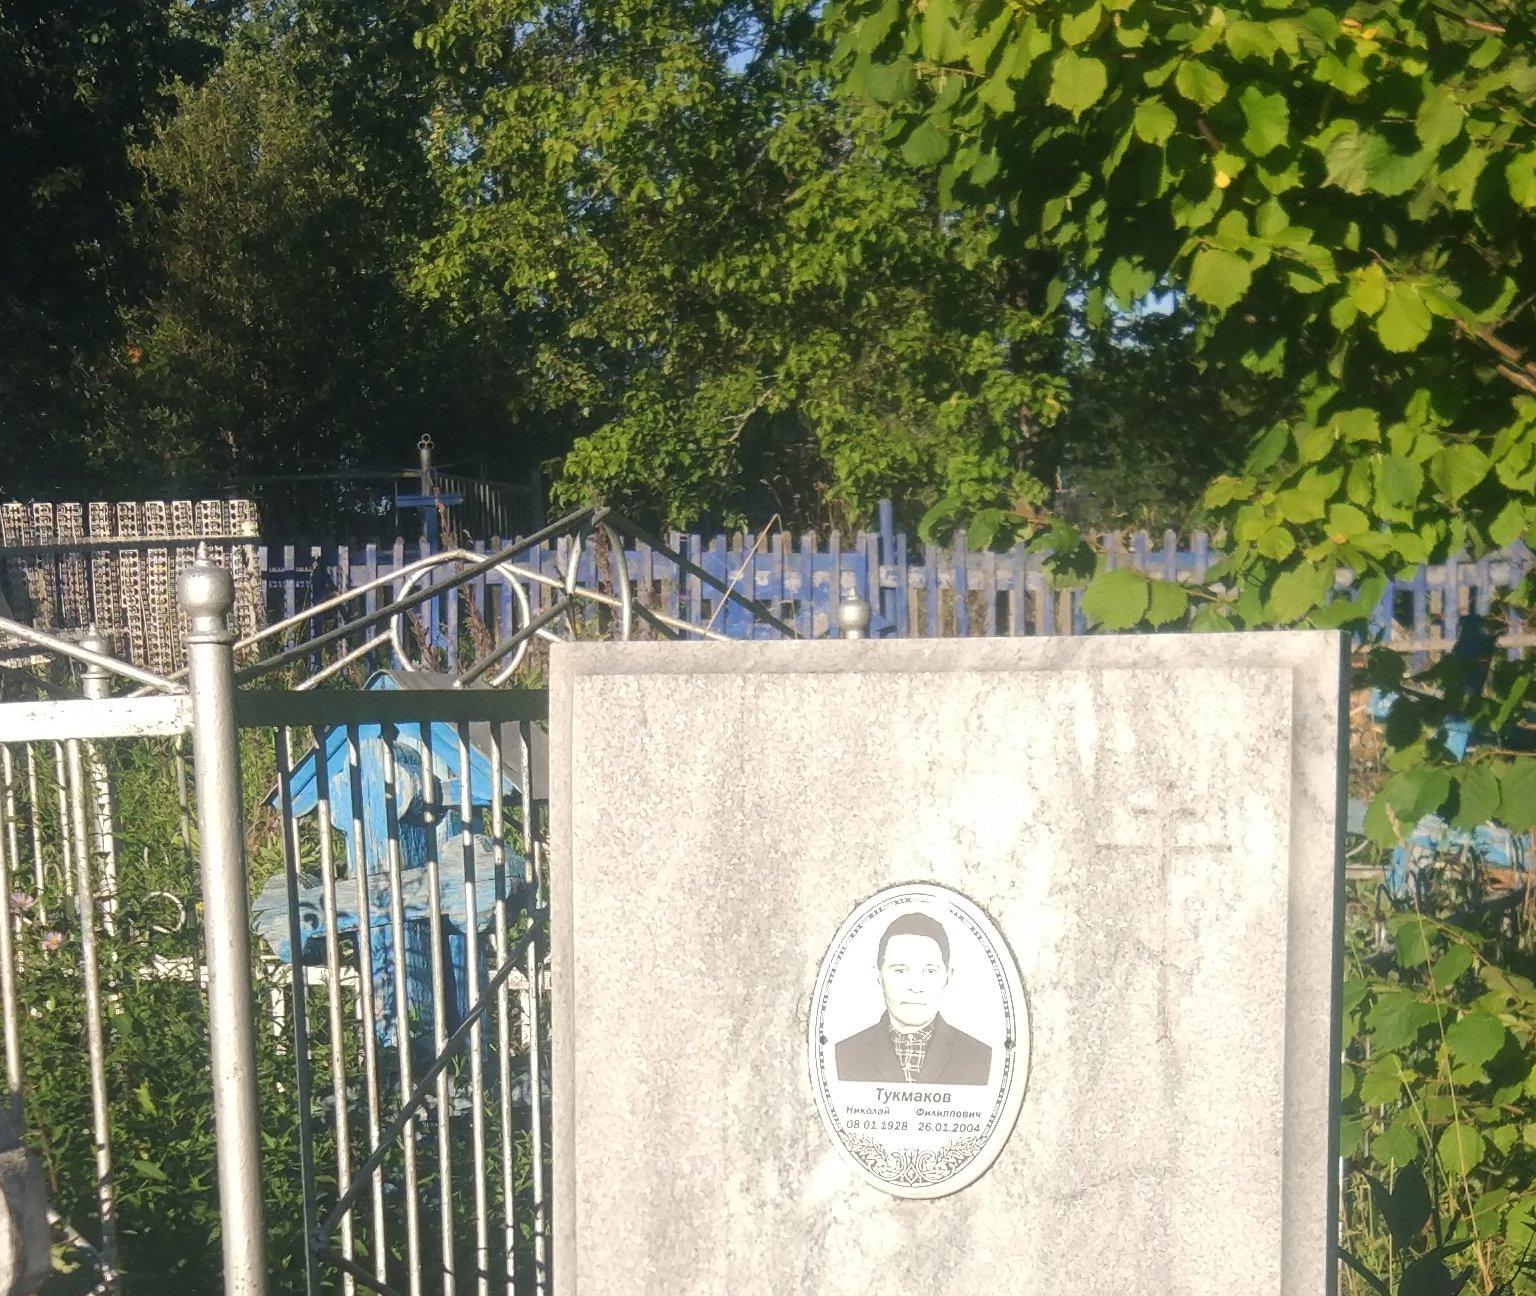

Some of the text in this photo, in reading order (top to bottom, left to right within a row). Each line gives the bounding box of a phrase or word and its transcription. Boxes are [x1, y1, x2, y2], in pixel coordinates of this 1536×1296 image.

[876, 1088, 952, 1104] Тукмаков
[846, 1106, 982, 1119] Николай Филиппович
[846, 1119, 981, 1133] 0801.1928 26.01.2004
